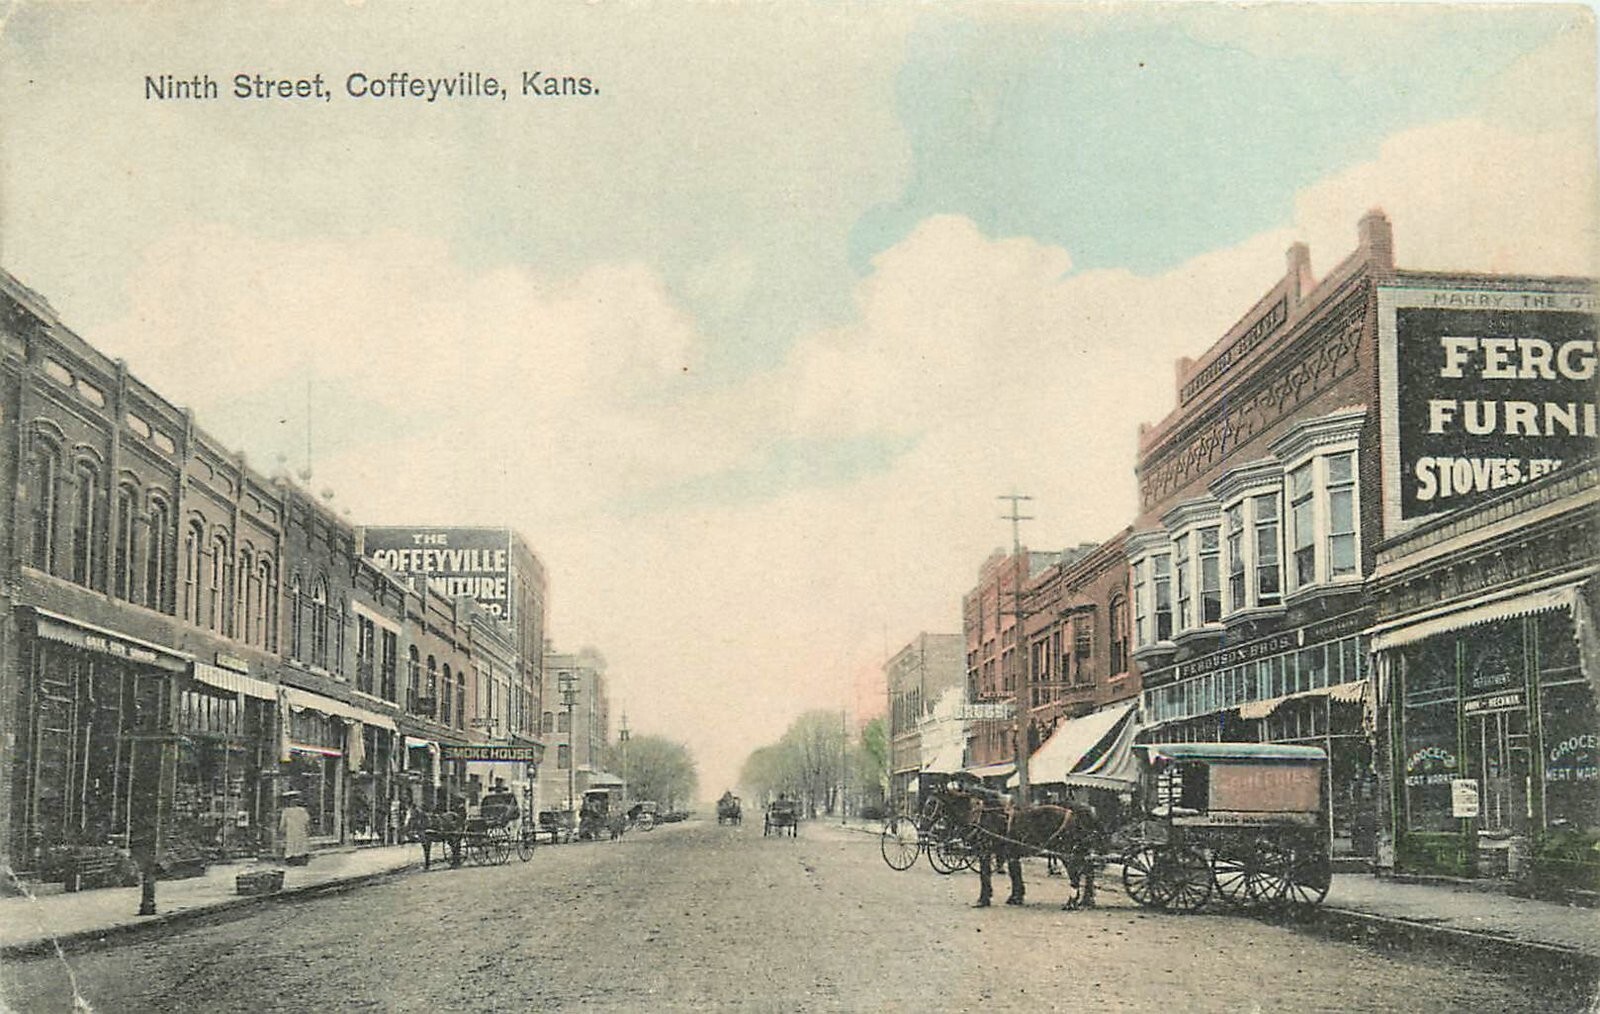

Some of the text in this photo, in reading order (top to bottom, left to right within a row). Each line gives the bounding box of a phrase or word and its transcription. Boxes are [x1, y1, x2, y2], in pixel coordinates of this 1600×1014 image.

[1433, 293, 1505, 306] MARRY
[1520, 294, 1558, 308] THE
[1440, 335, 1600, 381] FERG
[1428, 399, 1599, 438] FURNI
[412, 533, 448, 546] THE
[372, 548, 508, 573] COFFEYVILLE
[445, 747, 533, 760] SMOKE HOUSE
